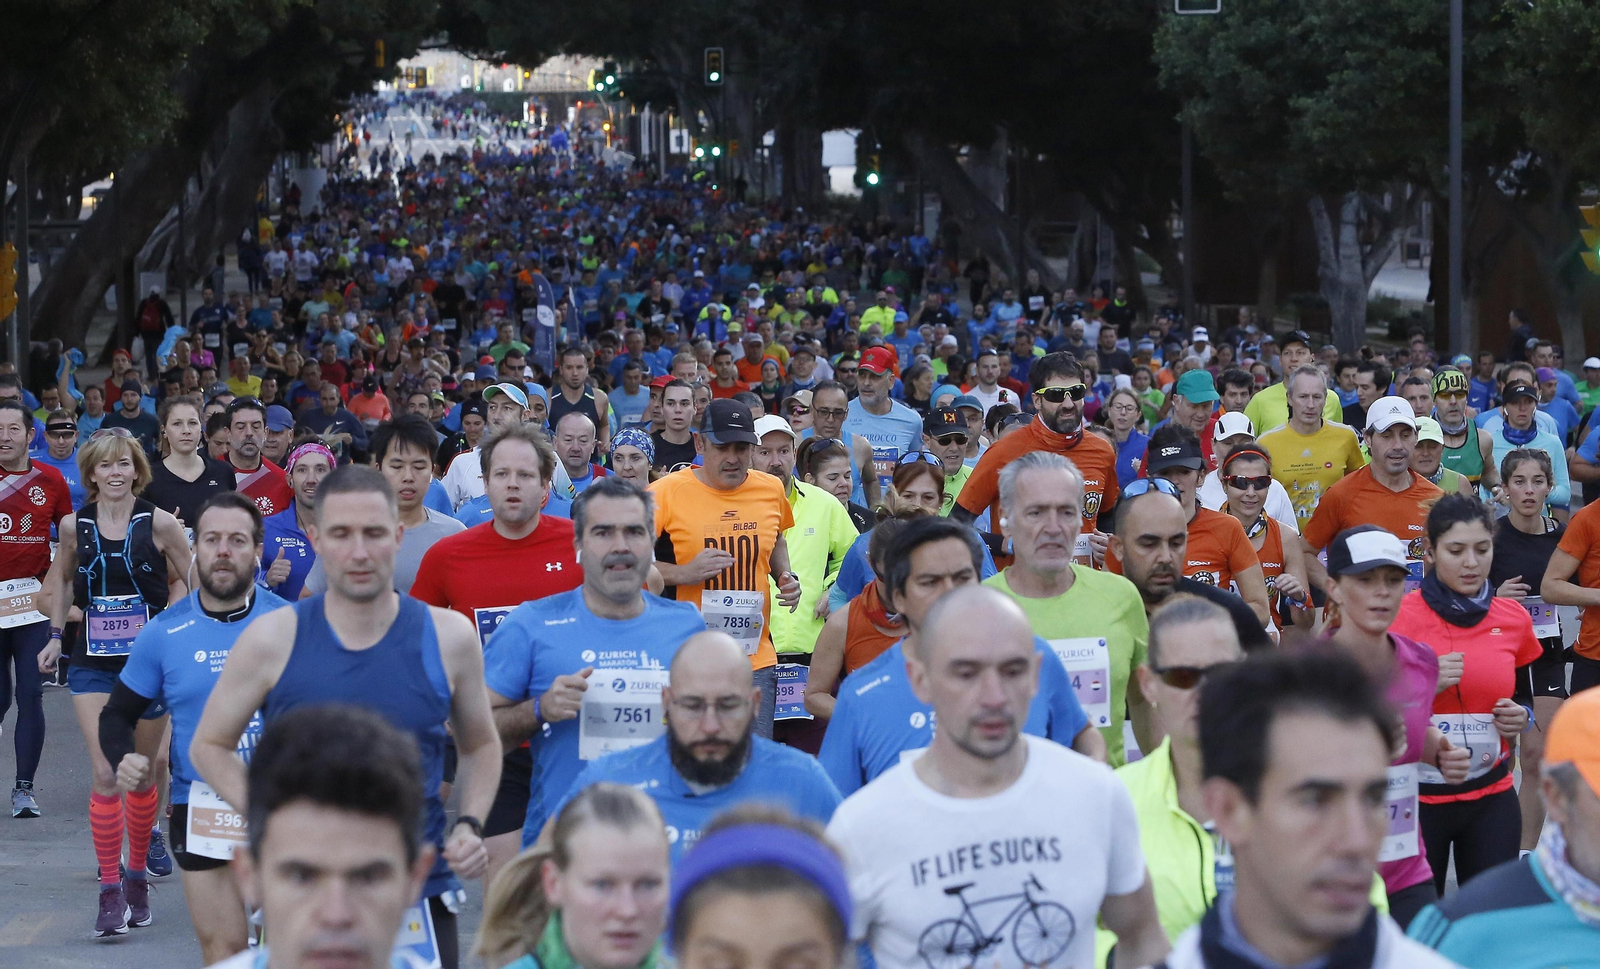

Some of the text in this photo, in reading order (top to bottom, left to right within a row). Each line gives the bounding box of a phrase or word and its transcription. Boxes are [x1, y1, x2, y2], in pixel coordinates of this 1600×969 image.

[861, 434, 897, 442] OROCCO
[16, 581, 35, 589] ZURICH
[10, 595, 32, 607] 5915
[1526, 606, 1540, 616] 13
[102, 619, 129, 631] 2879
[723, 616, 750, 628] 7836
[209, 650, 231, 658] ZUR
[598, 650, 637, 659] ZURICH
[1057, 648, 1095, 659] ZURICH
[613, 707, 651, 723] 7561
[1453, 723, 1488, 732] ZURICH
[214, 812, 249, 828] 596
[911, 837, 1062, 887] IF LIFE SUCKS
